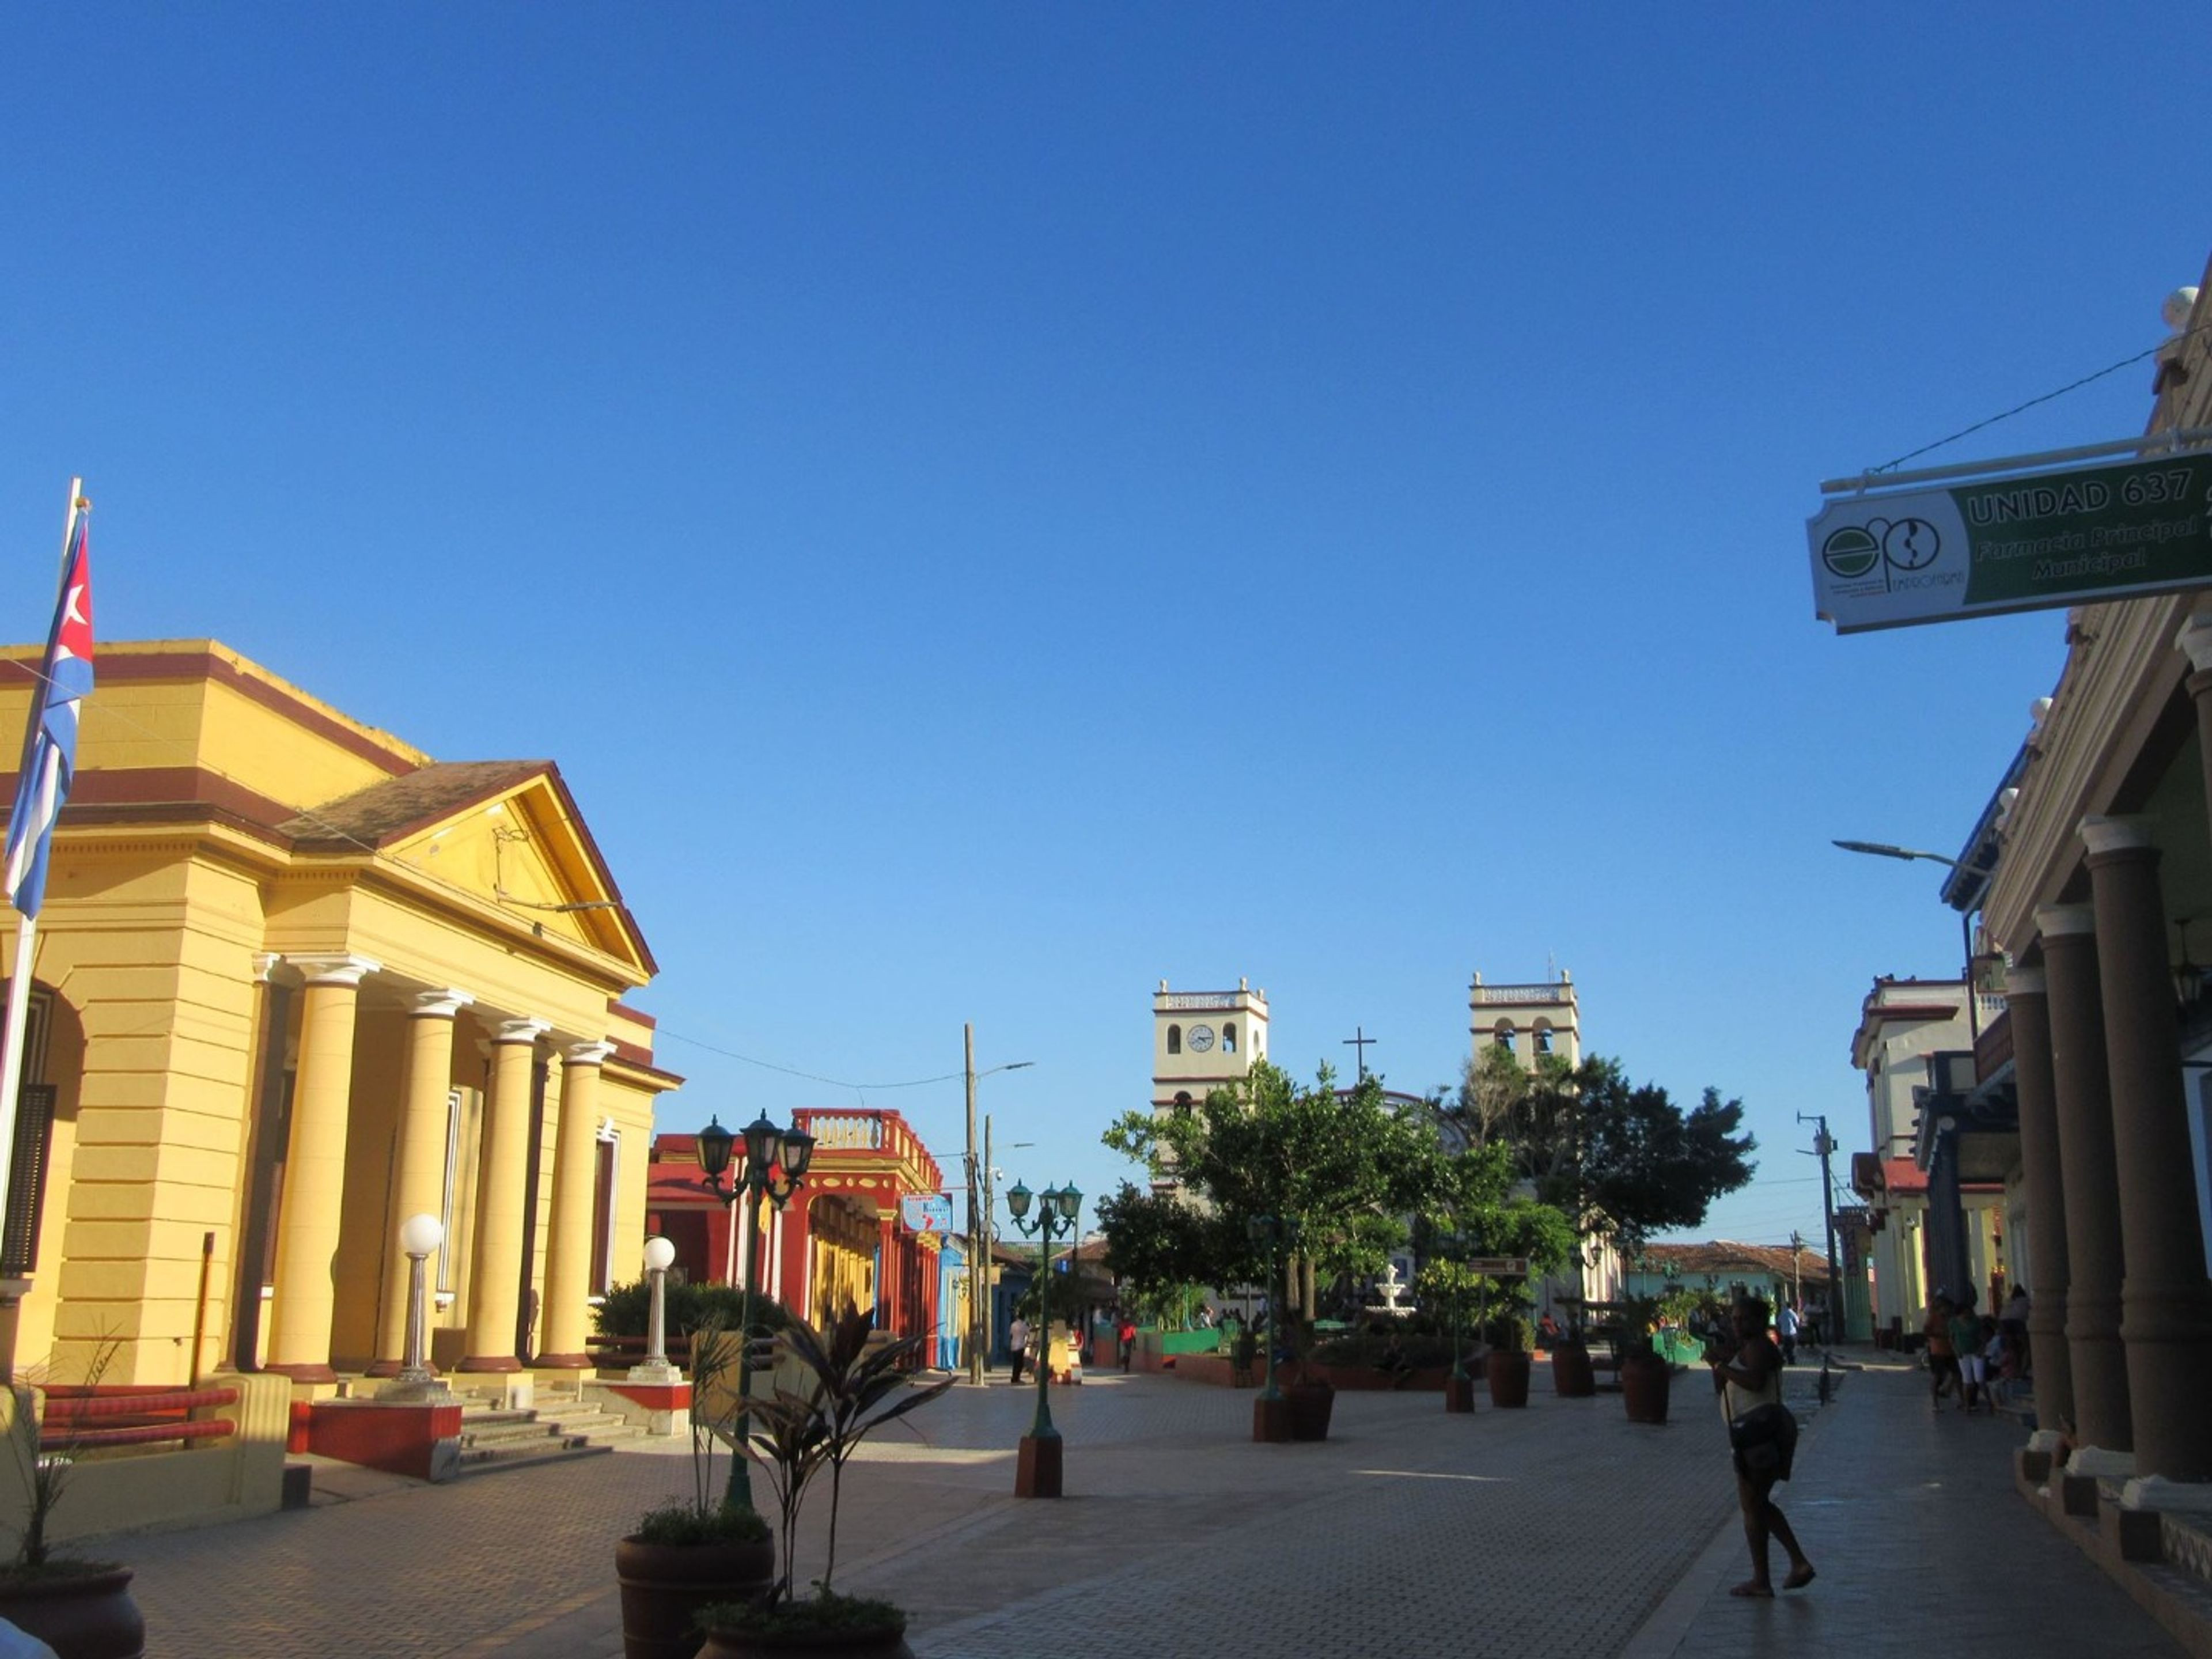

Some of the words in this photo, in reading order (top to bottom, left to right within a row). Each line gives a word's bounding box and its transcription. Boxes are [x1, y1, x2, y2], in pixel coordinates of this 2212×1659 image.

[1968, 480, 2109, 525] UNIDAD
[2123, 468, 2193, 505] 637
[1976, 531, 2085, 561] Farmacia
[2091, 514, 2198, 547] Principal
[2032, 547, 2145, 579] Municipal
